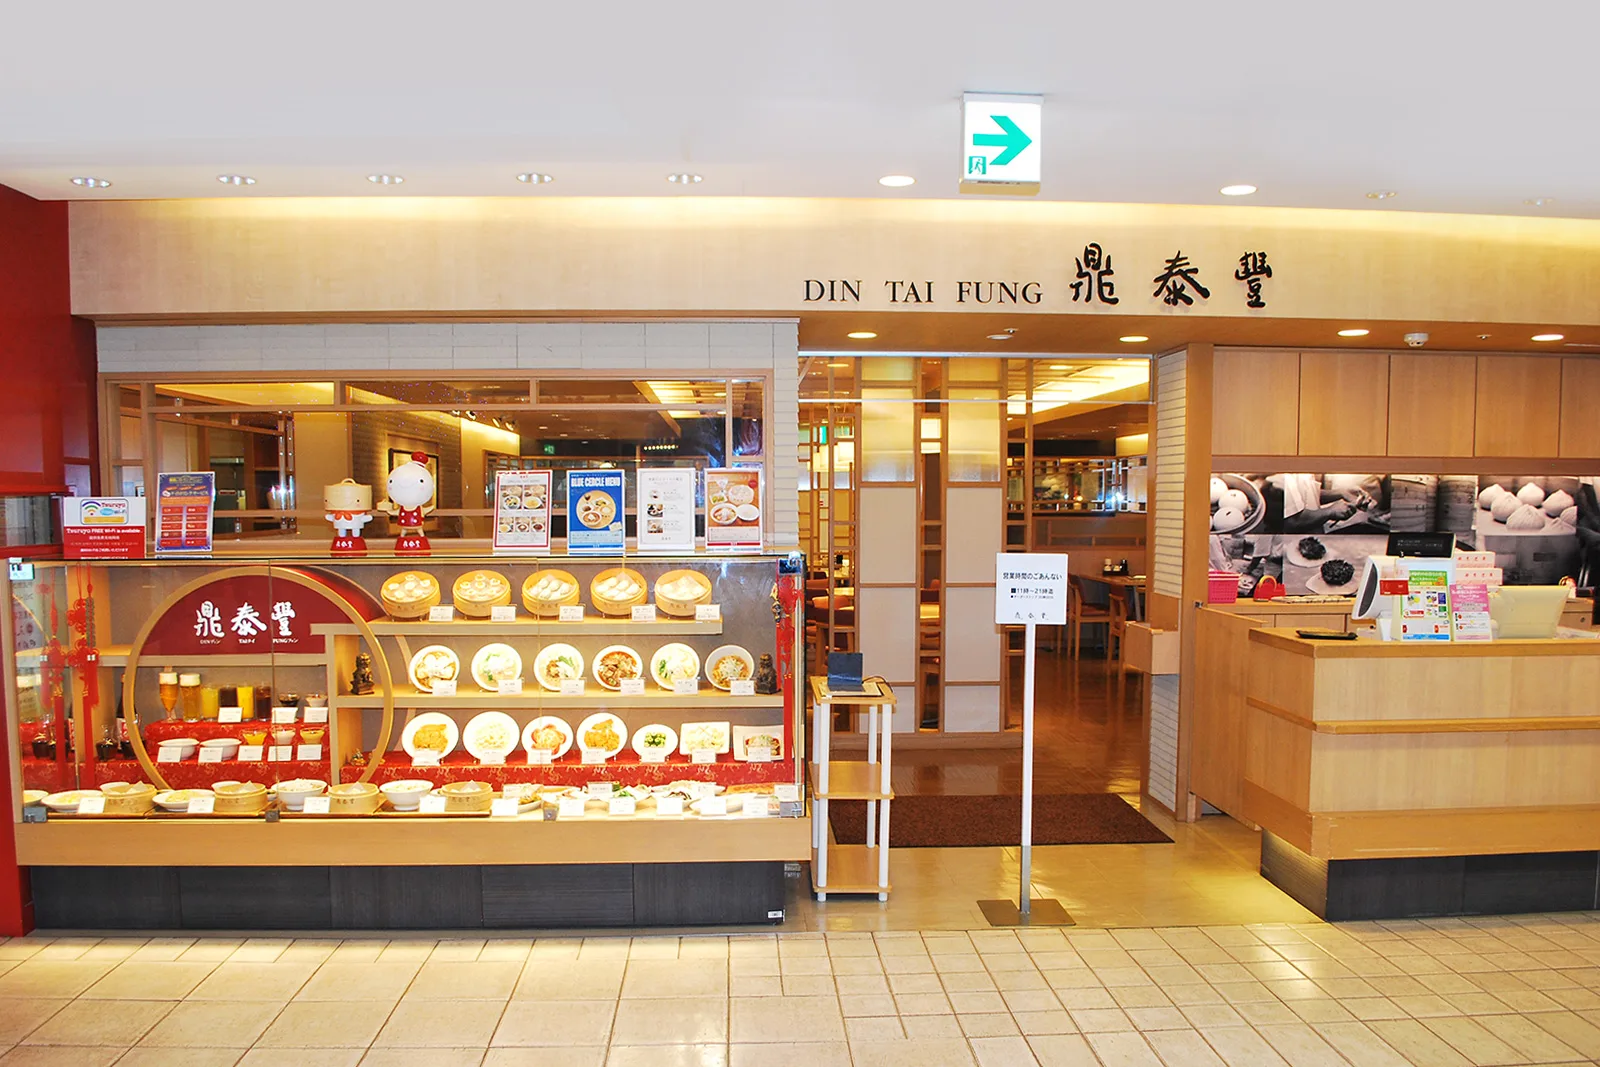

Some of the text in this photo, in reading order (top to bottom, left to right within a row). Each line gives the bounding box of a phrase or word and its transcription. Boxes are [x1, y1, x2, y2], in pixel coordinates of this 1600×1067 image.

[1069, 242, 1273, 308] 鼎泰豐
[803, 279, 1043, 304] DIN TAI FUNG
[1003, 572, 1062, 580] 営業時間のごあんない
[194, 600, 297, 638] 鼎泰豐
